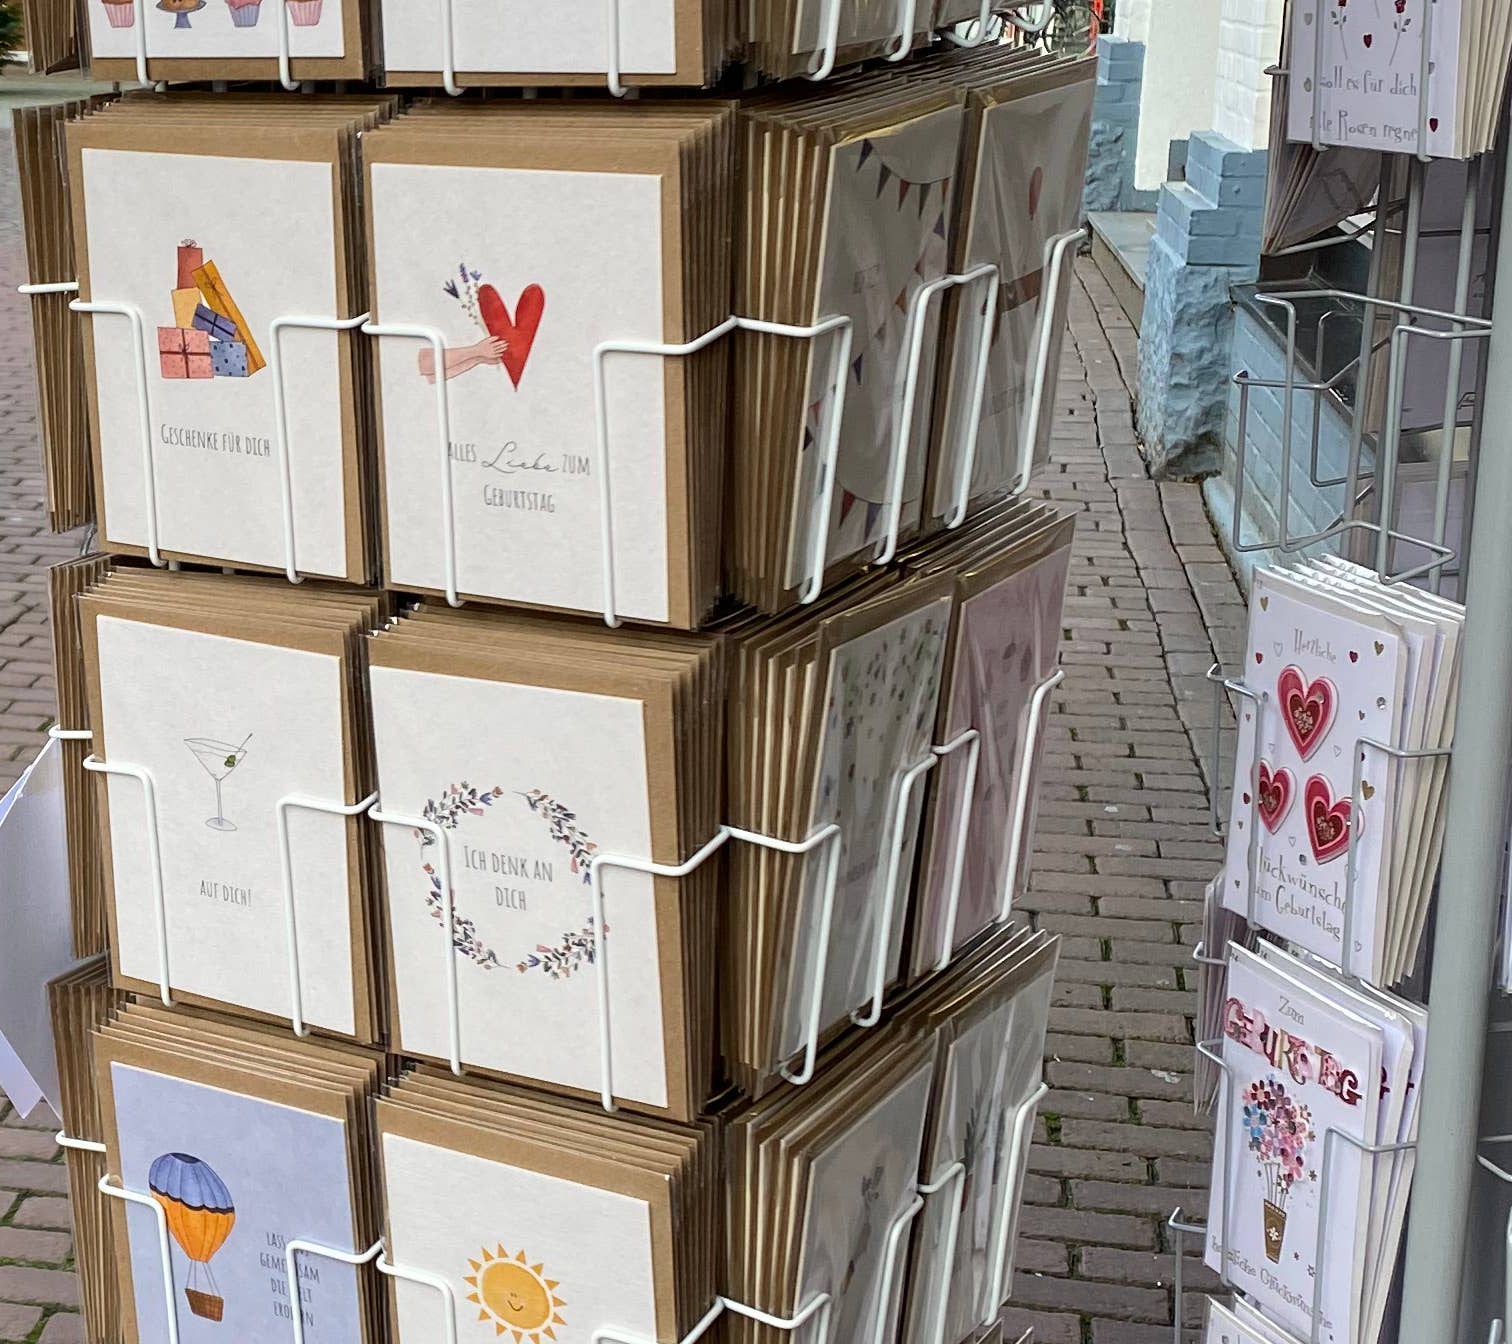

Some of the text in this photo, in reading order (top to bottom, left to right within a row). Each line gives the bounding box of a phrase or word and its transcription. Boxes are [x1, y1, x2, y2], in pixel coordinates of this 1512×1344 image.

[160, 423, 218, 451] GESCHENKE
[246, 436, 271, 457] DICH
[562, 453, 591, 476] ZUM
[483, 484, 556, 513] GEBURTSTAG
[464, 845, 553, 883] ICH DENK AN
[199, 879, 220, 899] AUF
[495, 885, 527, 911] DICH
[259, 1251, 321, 1284] GEMESAM
